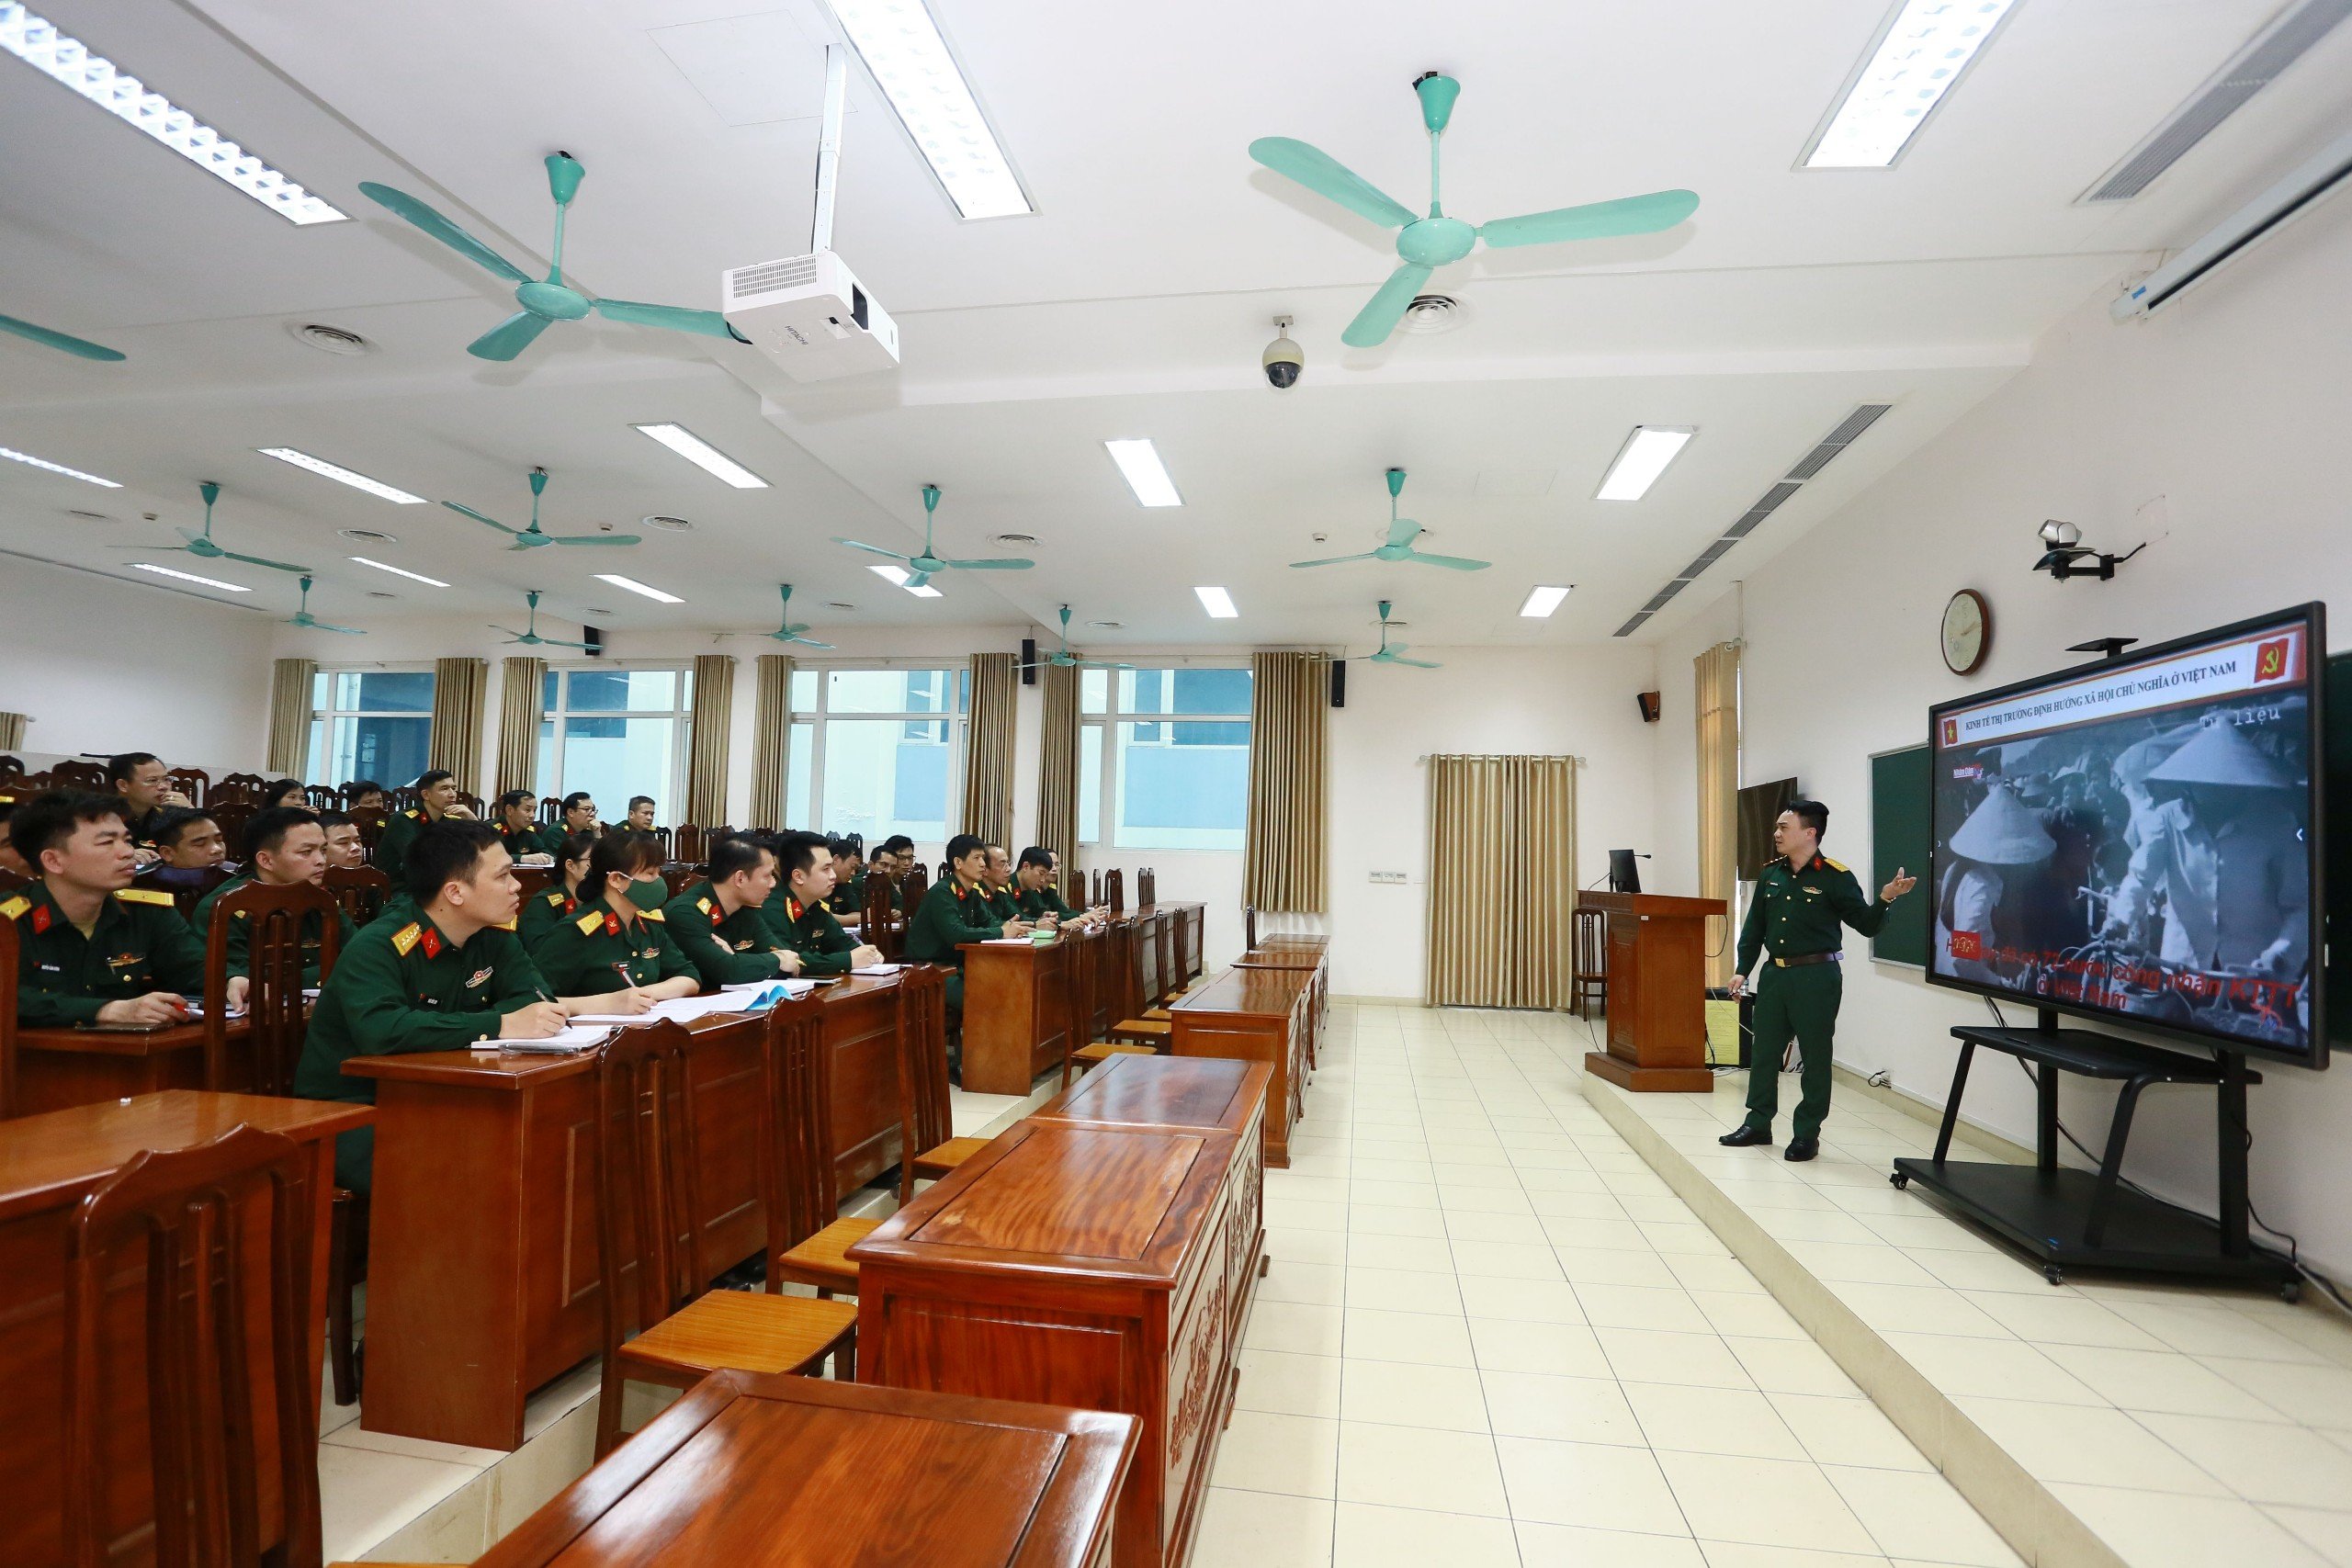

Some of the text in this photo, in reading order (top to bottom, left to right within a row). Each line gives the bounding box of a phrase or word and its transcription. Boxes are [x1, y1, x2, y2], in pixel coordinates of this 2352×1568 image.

[785, 325, 808, 344] HITACHI
[1965, 720, 1981, 731] KINH
[1991, 714, 2002, 726] THỊ
[2004, 707, 2032, 722] TRƯỜNG
[2034, 703, 2052, 717] ĐỊNH
[2053, 695, 2083, 711] HƯỚNG
[2084, 691, 2096, 705] XÃ
[2098, 688, 2114, 703] HỘI
[2116, 681, 2135, 698] CHỦ
[2137, 675, 2169, 694] NGHĨA
[2171, 671, 2180, 685] Ở
[2182, 667, 2207, 683] VIỆT
[2210, 660, 2236, 678] NAM
[2233, 706, 2280, 726] liệu
[2113, 962, 2162, 991] công
[2165, 970, 2222, 998] nhận
